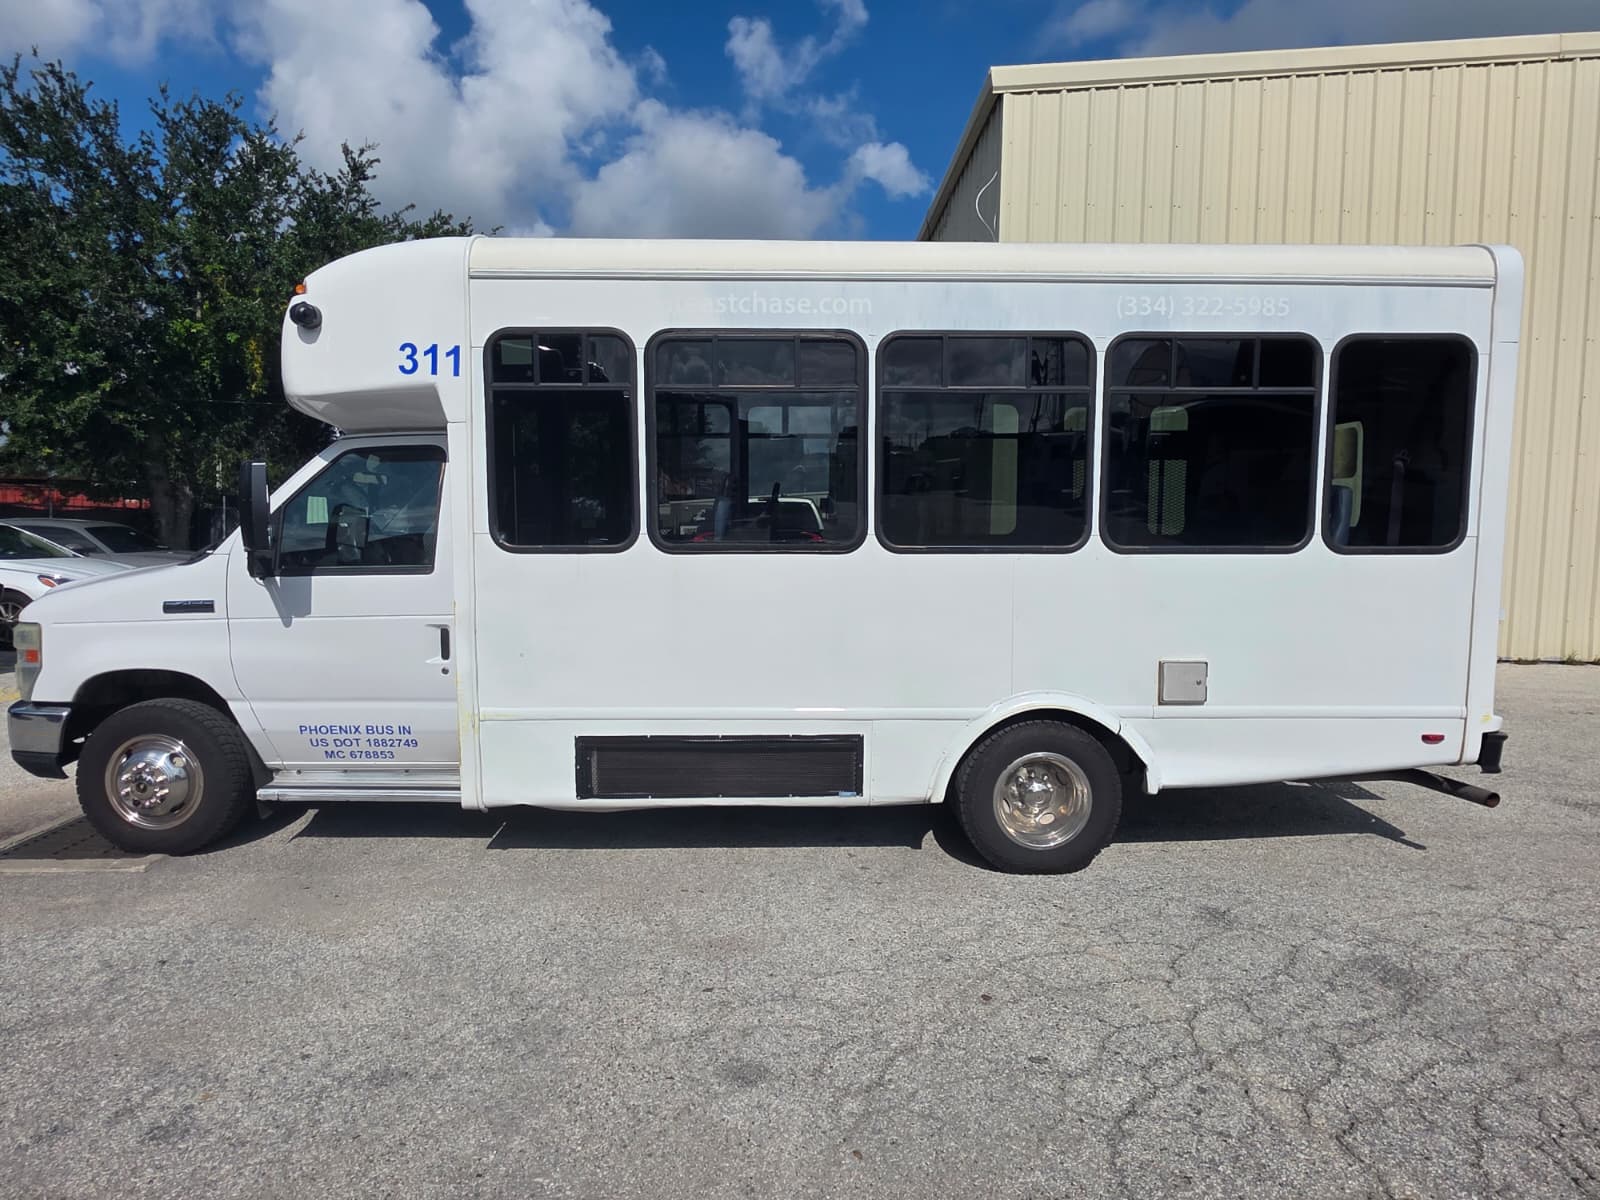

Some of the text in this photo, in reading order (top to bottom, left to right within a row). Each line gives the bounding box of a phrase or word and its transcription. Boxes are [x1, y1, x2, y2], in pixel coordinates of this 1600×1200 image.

[1116, 295, 1291, 319] (334) 322-5985
[398, 342, 461, 377] 311
[298, 724, 412, 735] PHOENIX BUS IN
[309, 738, 418, 748] US DOT 1882749
[324, 750, 395, 759] MC 678853
